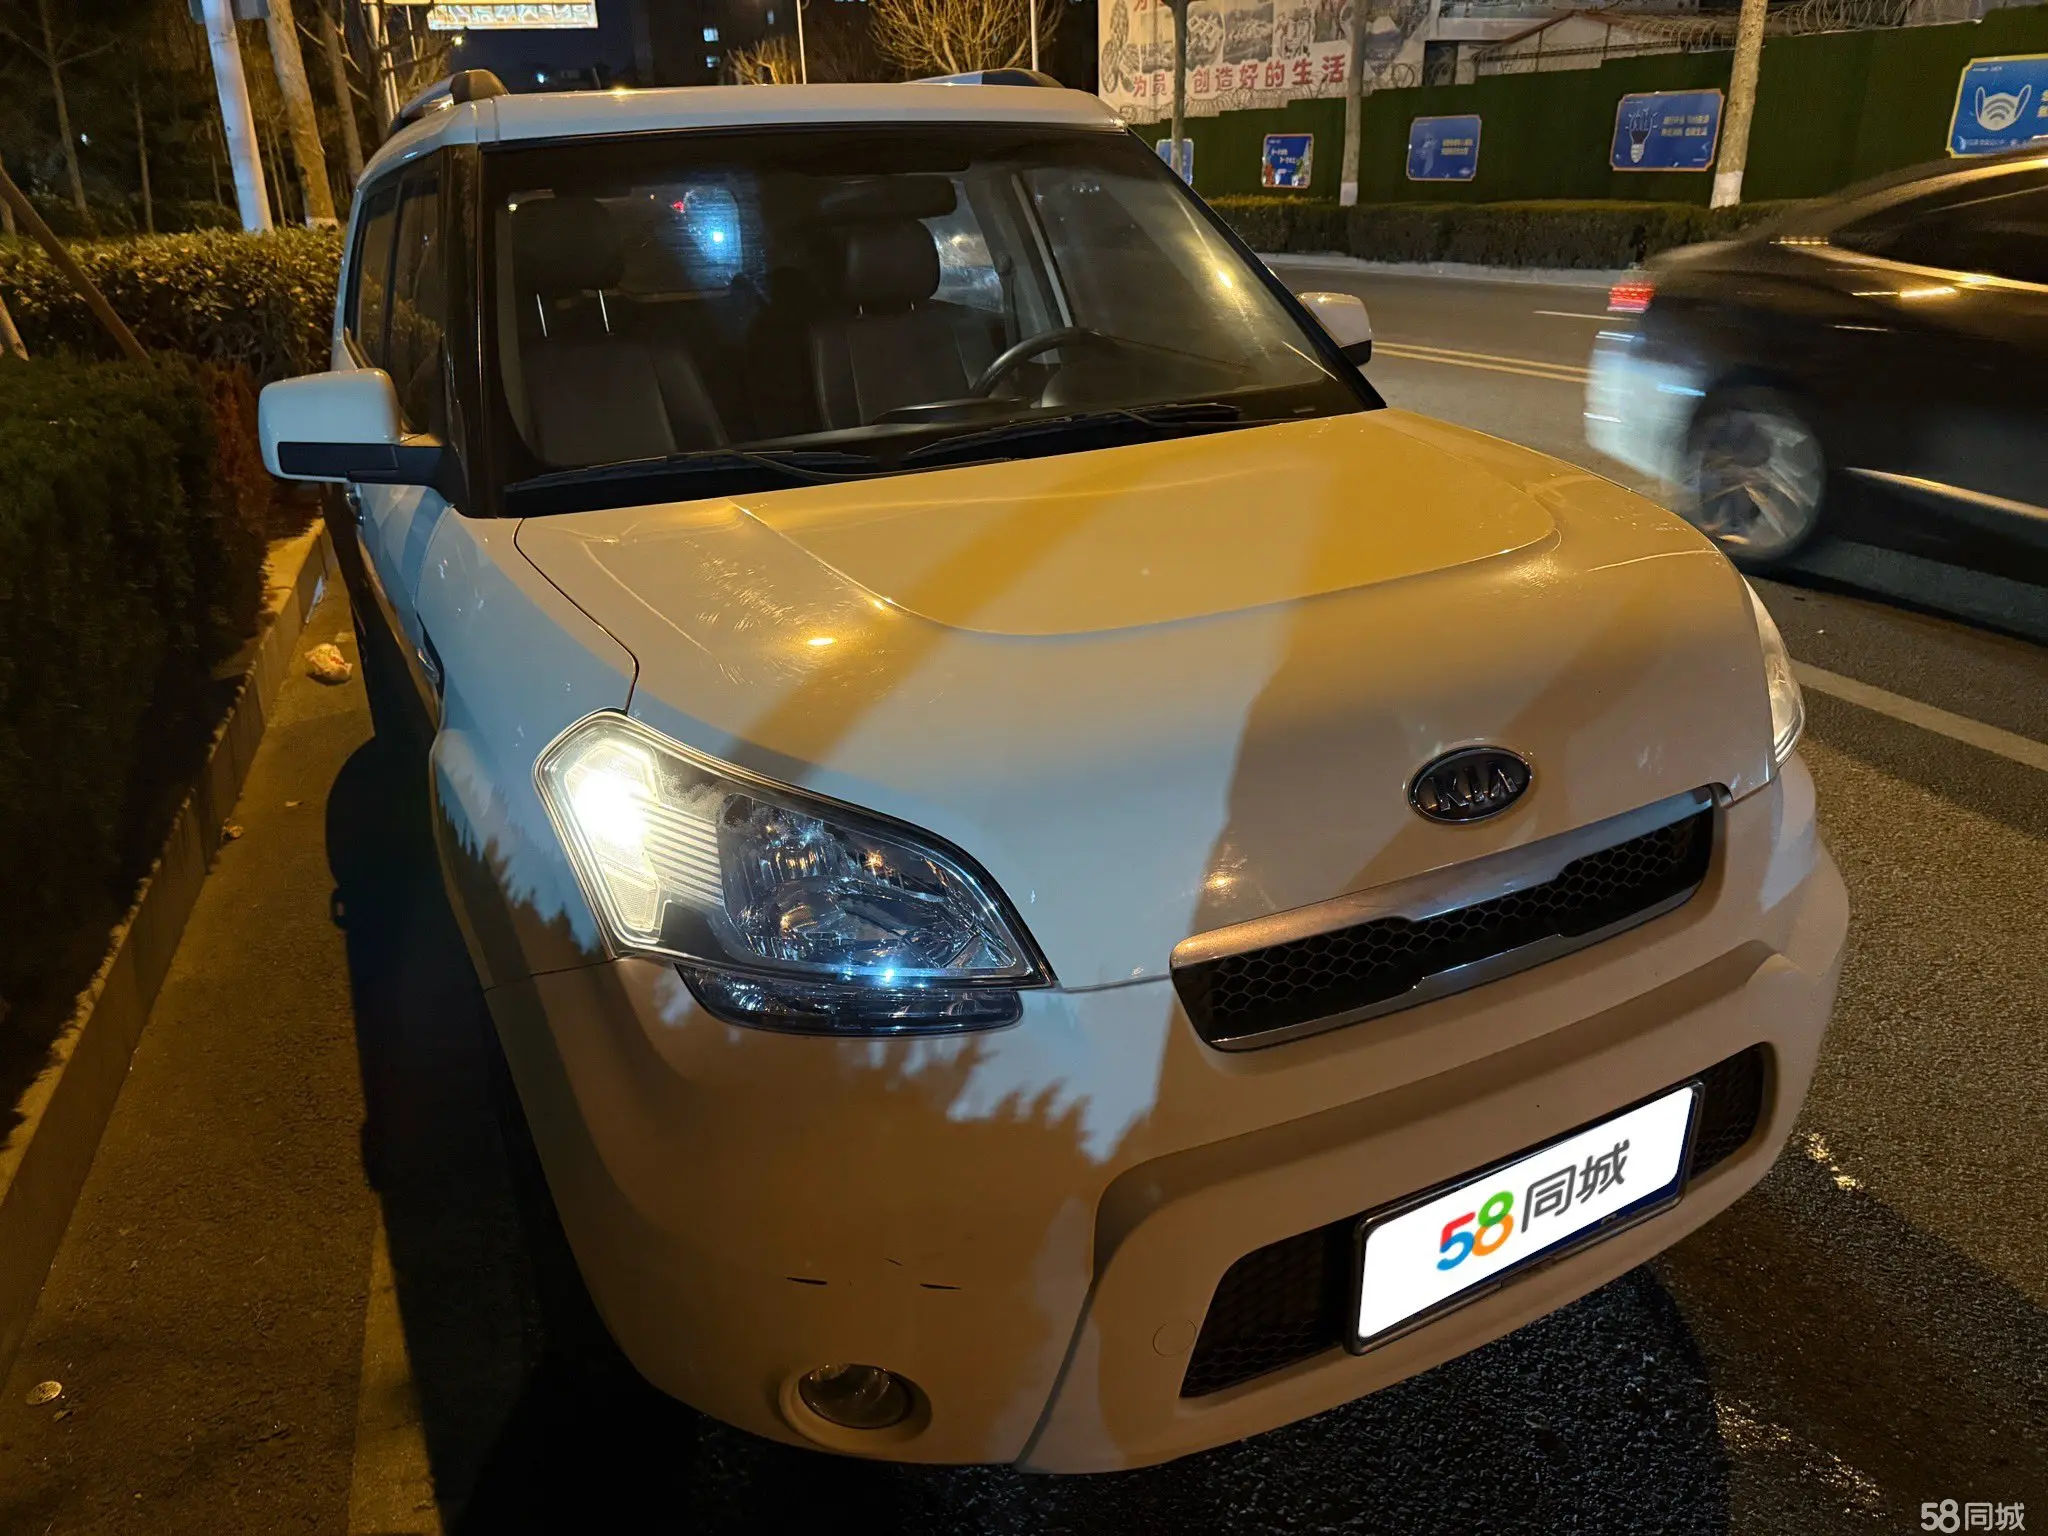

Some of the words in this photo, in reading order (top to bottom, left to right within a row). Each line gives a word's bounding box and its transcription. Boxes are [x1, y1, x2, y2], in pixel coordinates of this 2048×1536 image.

[1132, 54, 1346, 97] 为员创造好的生活
[1415, 757, 1521, 814] KIA
